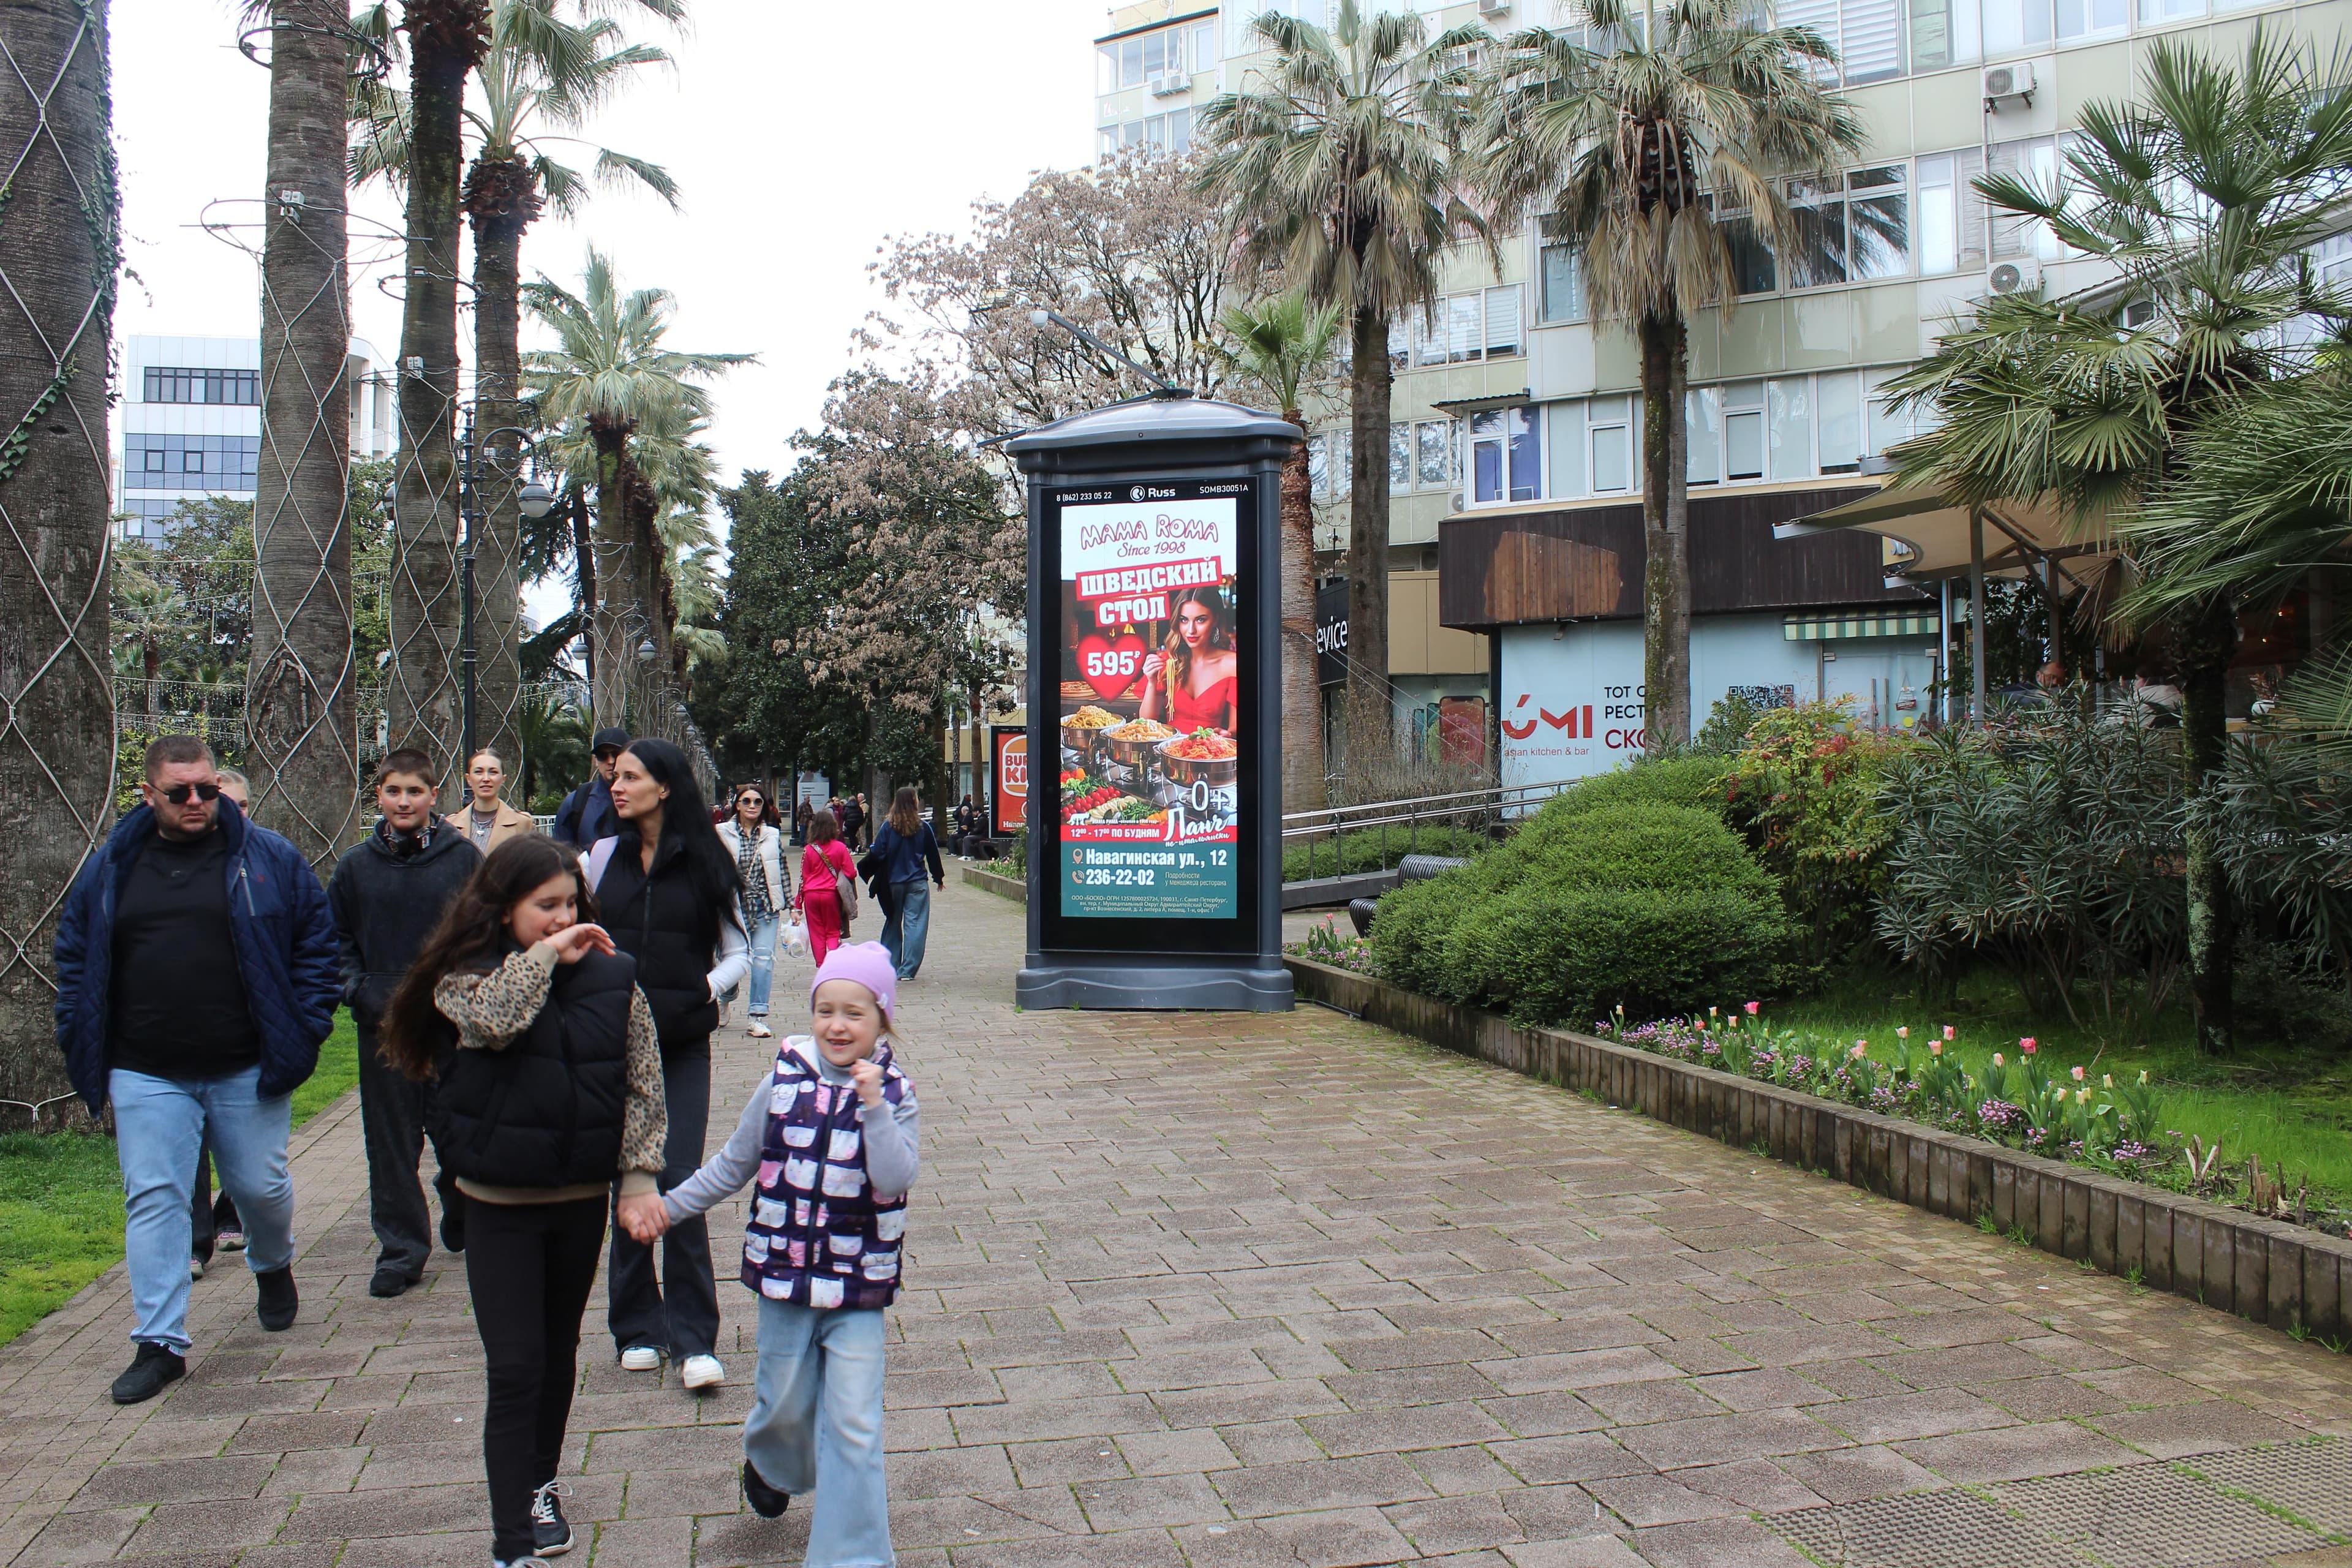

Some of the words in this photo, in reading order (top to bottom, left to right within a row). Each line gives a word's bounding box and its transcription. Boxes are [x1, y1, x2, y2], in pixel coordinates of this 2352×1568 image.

[1062, 493, 1079, 502] (862)
[1148, 488, 1176, 497] Russ
[1080, 520, 1148, 550] MAMA
[1156, 514, 1218, 543] ROMA
[1117, 541, 1150, 557] Since
[1154, 541, 1186, 554] 1998
[1080, 556, 1218, 597] ШВЕДСКИЙ
[1099, 596, 1166, 625] СТОЛ
[1604, 686, 1631, 698] ТОТ
[1504, 748, 1528, 757] asian
[1531, 746, 1562, 756] kitchen
[1565, 747, 1572, 755] &
[1574, 746, 1591, 755] bar
[1191, 780, 1229, 812] 0+
[1163, 807, 1229, 842] Ланч
[1111, 829, 1124, 837] ПО
[1125, 829, 1160, 839] БУДНЯМ
[1086, 848, 1175, 865] Навагинская
[1178, 853, 1205, 869] ул.,
[1210, 849, 1227, 865] 12
[1086, 869, 1155, 886] 236-22-02
